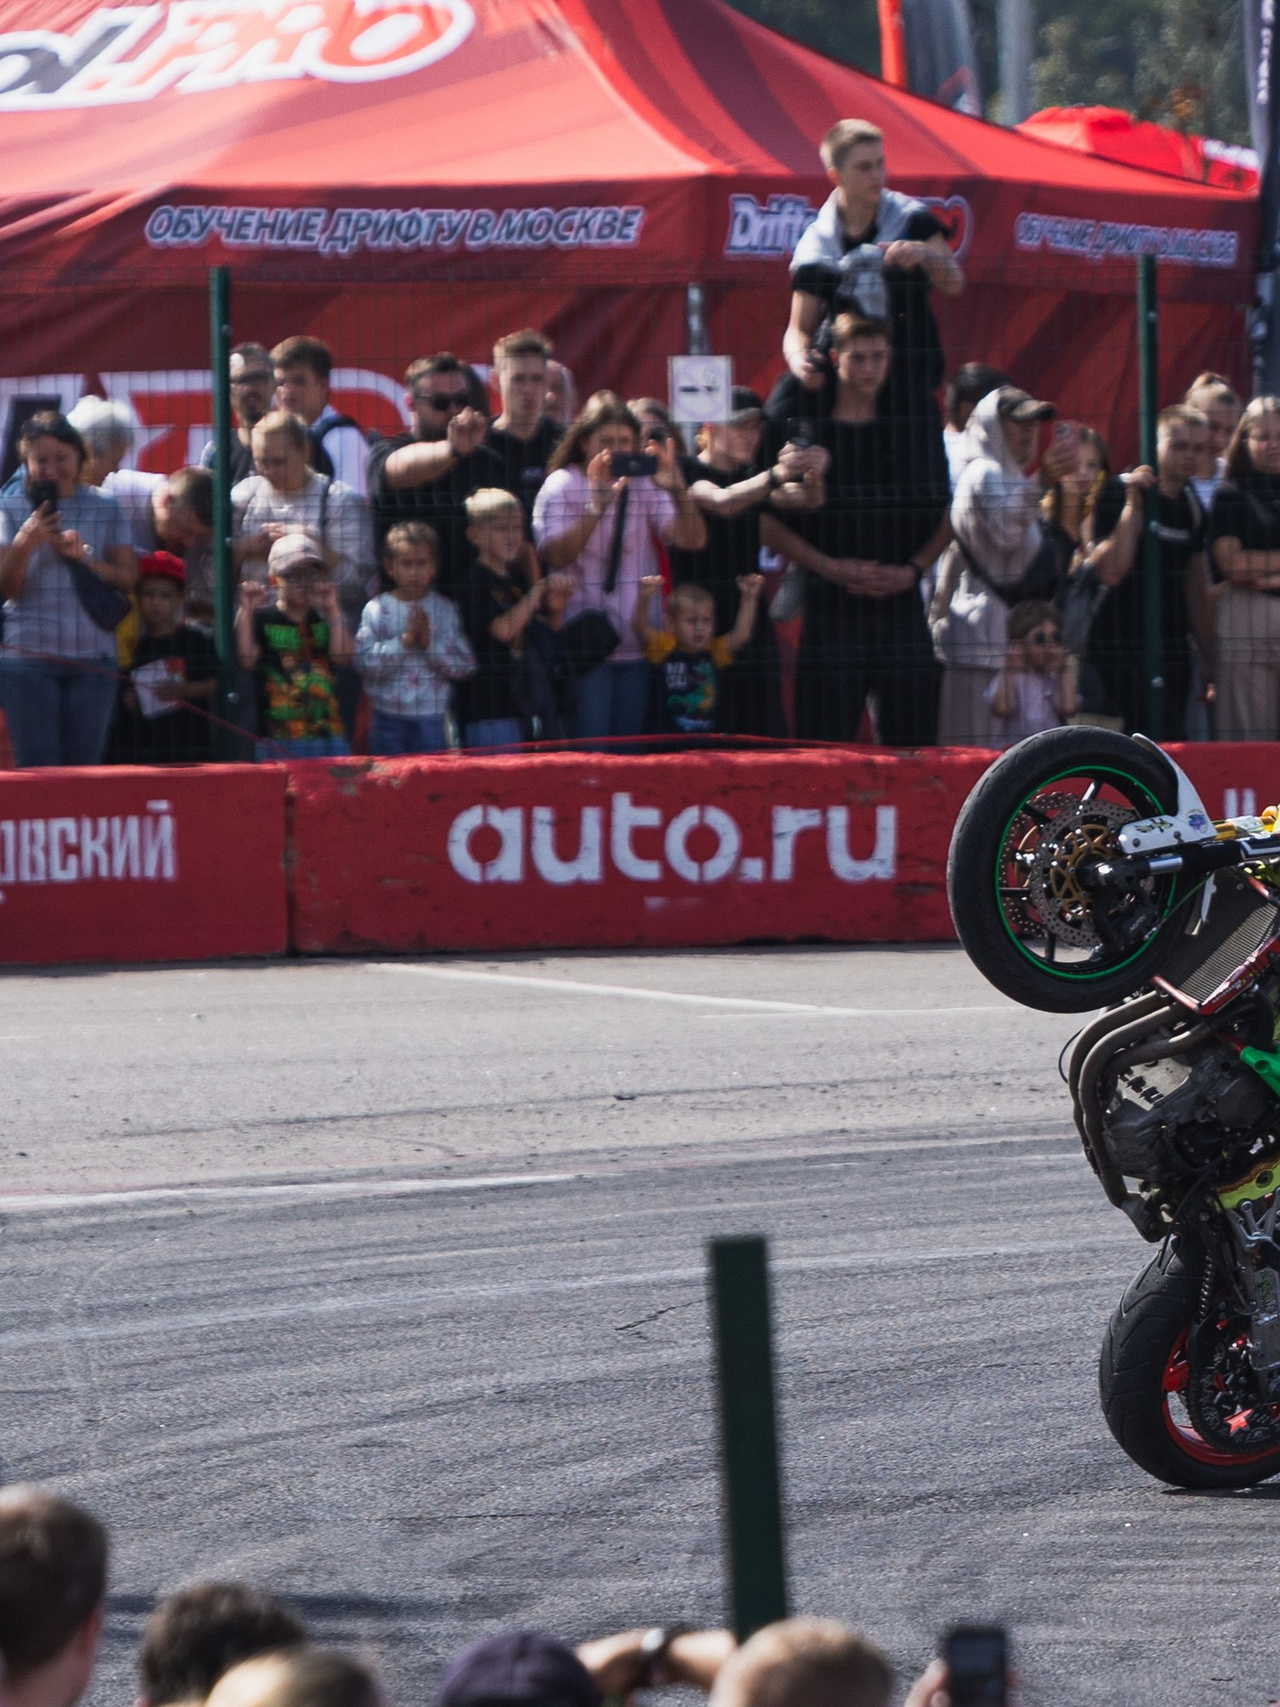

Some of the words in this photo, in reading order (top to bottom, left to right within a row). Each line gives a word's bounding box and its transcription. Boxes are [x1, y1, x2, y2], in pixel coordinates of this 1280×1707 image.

[145, 205, 326, 249] ОБУЧЕНИЕ
[319, 207, 472, 254] ДРИФТУ
[466, 208, 496, 246] В
[492, 205, 644, 245] МОСКВЕ
[447, 792, 897, 883] auto.ru
